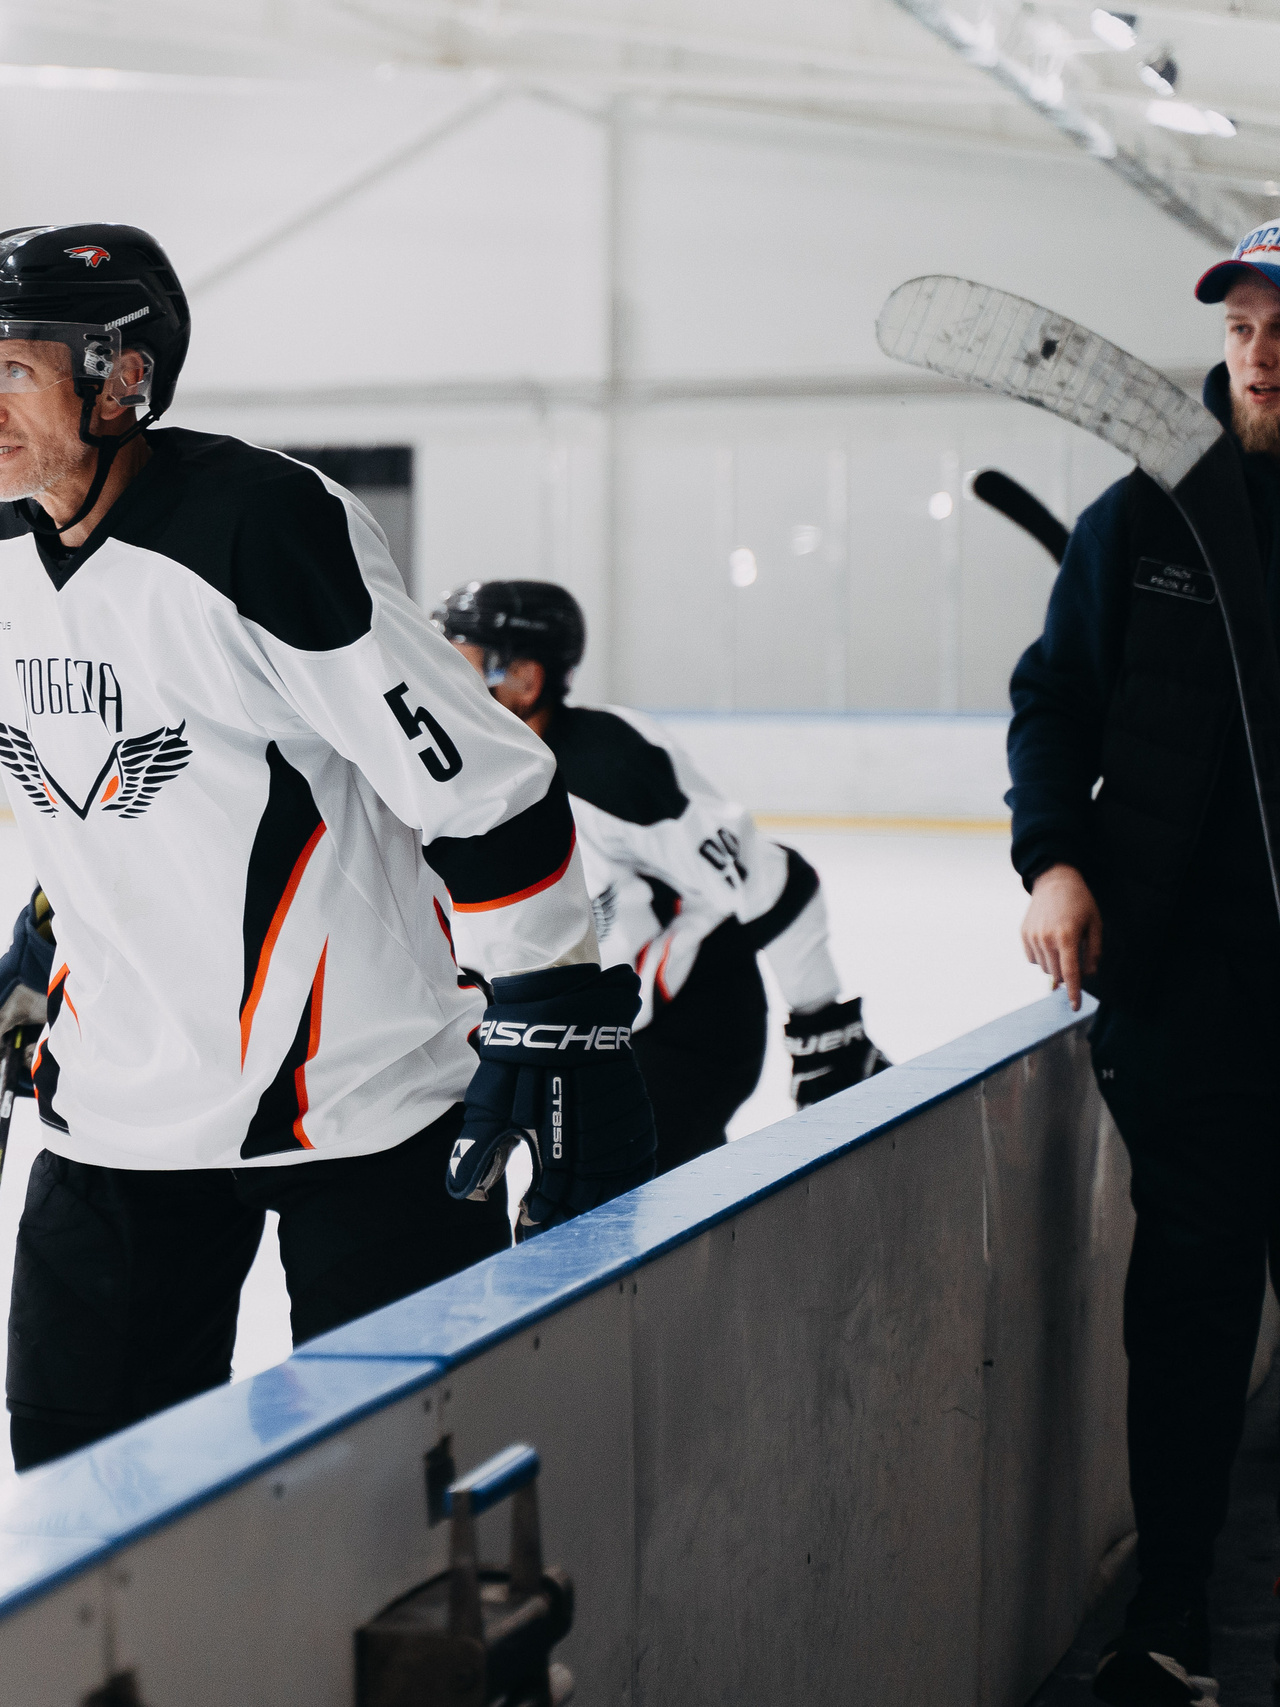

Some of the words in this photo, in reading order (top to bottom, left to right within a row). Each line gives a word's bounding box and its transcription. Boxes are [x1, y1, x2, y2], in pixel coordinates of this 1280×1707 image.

[105, 306, 150, 331] WARRIOR
[383, 681, 463, 782] 5
[480, 1020, 632, 1050] FISCHER
[552, 1076, 563, 1160] CT850
